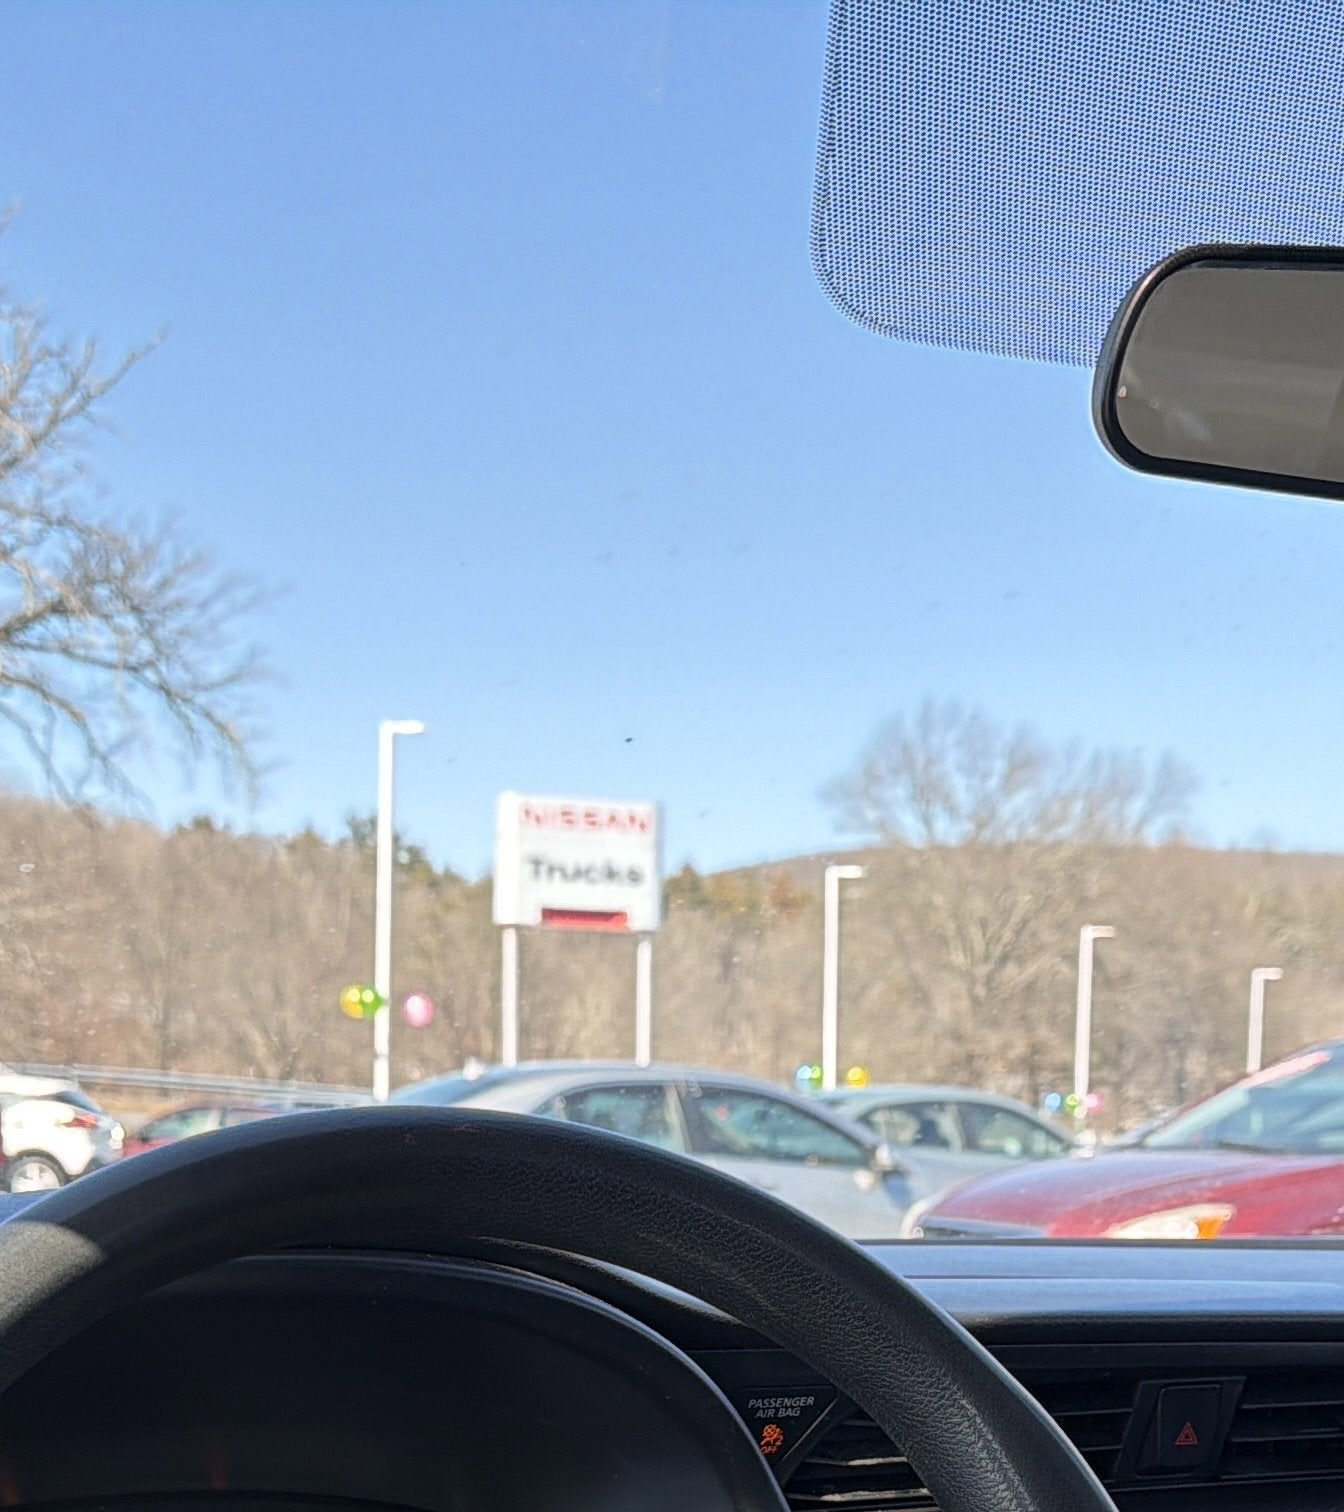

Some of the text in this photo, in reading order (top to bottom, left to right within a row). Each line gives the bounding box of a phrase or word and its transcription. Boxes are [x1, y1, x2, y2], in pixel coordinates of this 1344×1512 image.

[519, 804, 649, 833] NISSAN
[527, 857, 645, 887] Trucks
[747, 1396, 815, 1409] PASSENGER
[755, 1407, 802, 1419] AIR BAG
